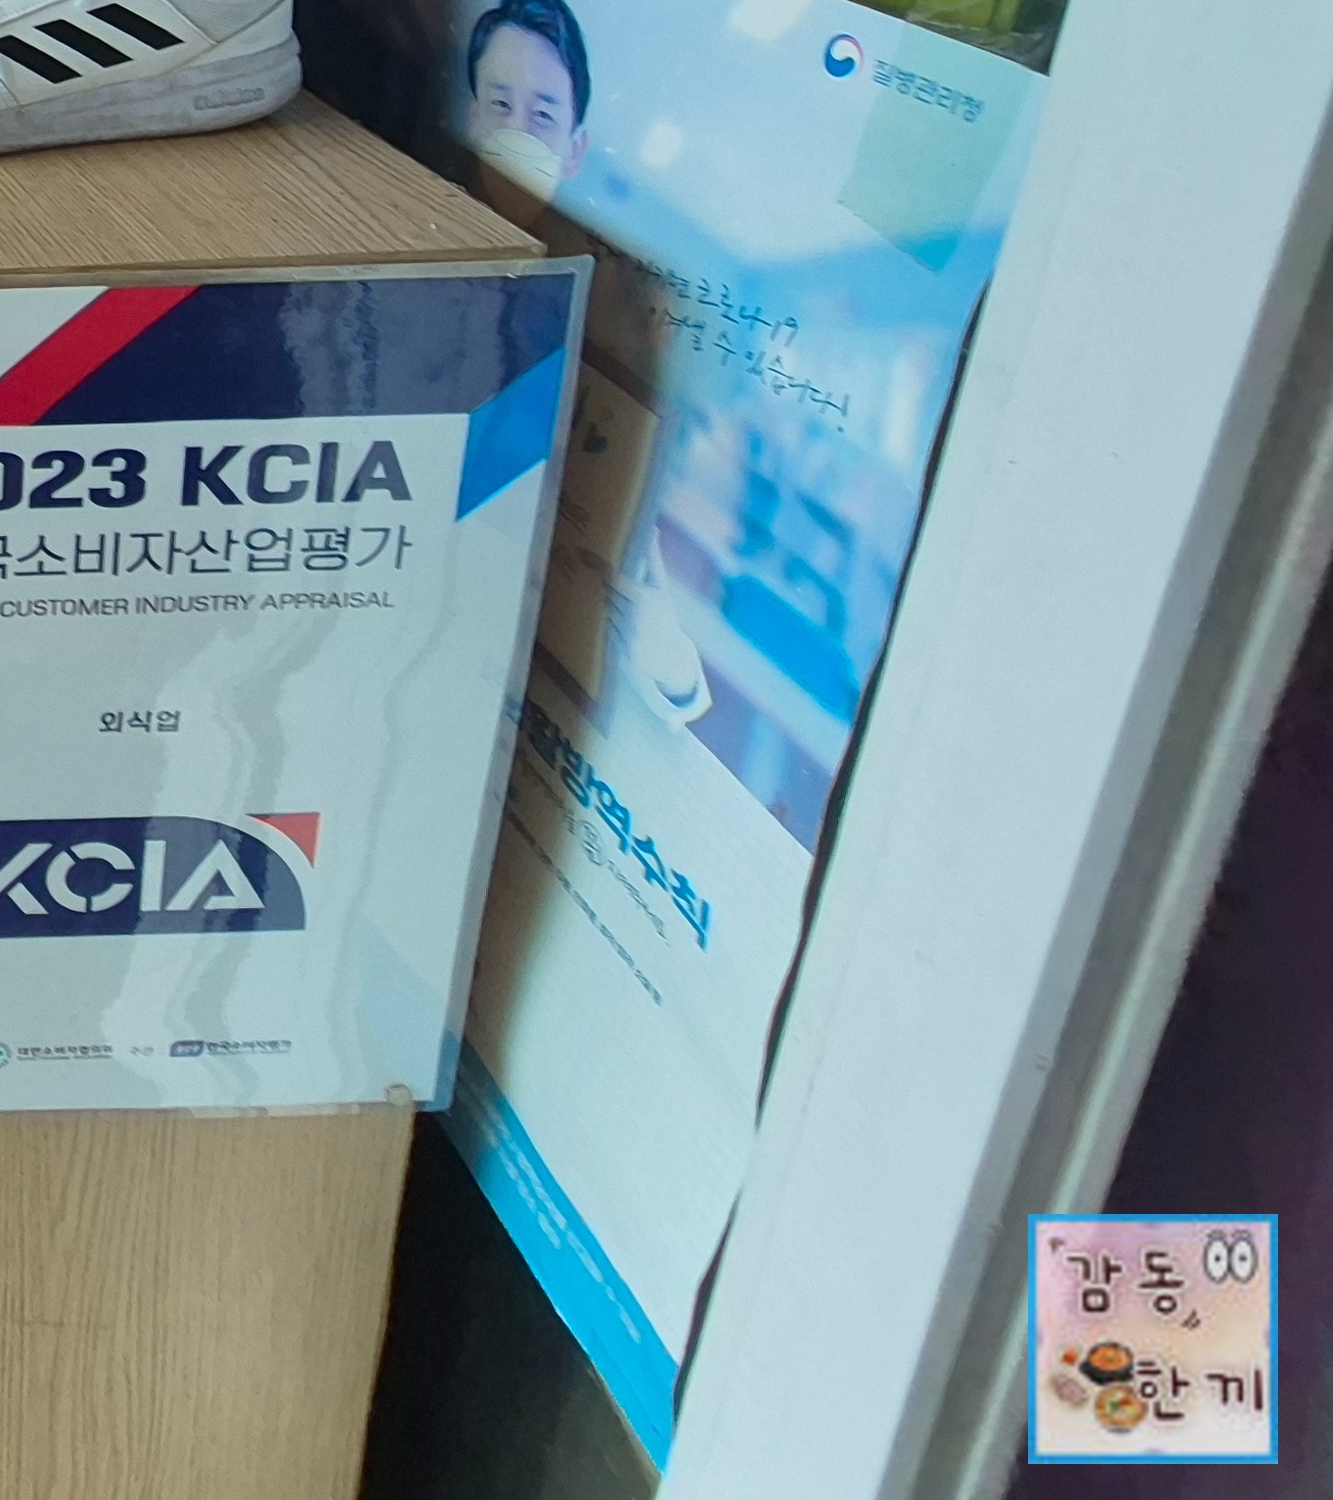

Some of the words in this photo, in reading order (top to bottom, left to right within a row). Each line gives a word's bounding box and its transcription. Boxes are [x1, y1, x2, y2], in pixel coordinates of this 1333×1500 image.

[180, 440, 413, 506] KCIA
[135, 594, 258, 615] INDUSTRY
[259, 590, 396, 611] APPRAISAL
[98, 709, 182, 734] 외식업
